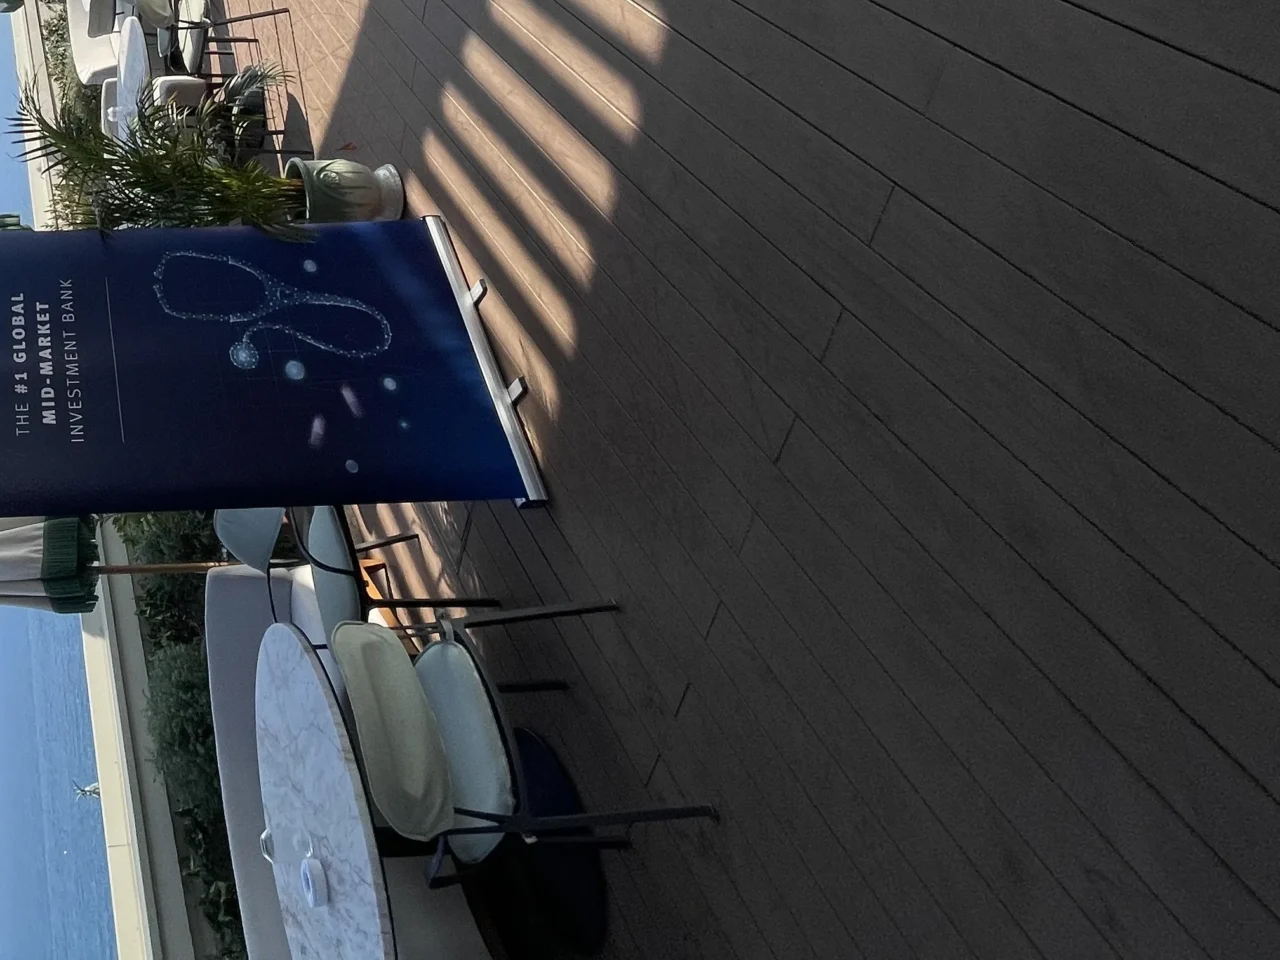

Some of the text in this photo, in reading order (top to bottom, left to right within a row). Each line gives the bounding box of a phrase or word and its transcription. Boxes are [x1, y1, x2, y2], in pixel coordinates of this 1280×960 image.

[11, 292, 30, 436] THE #1 GLOBAL
[36, 301, 57, 425] MID-MARKET
[59, 279, 85, 442] INVESTMENT BANK
